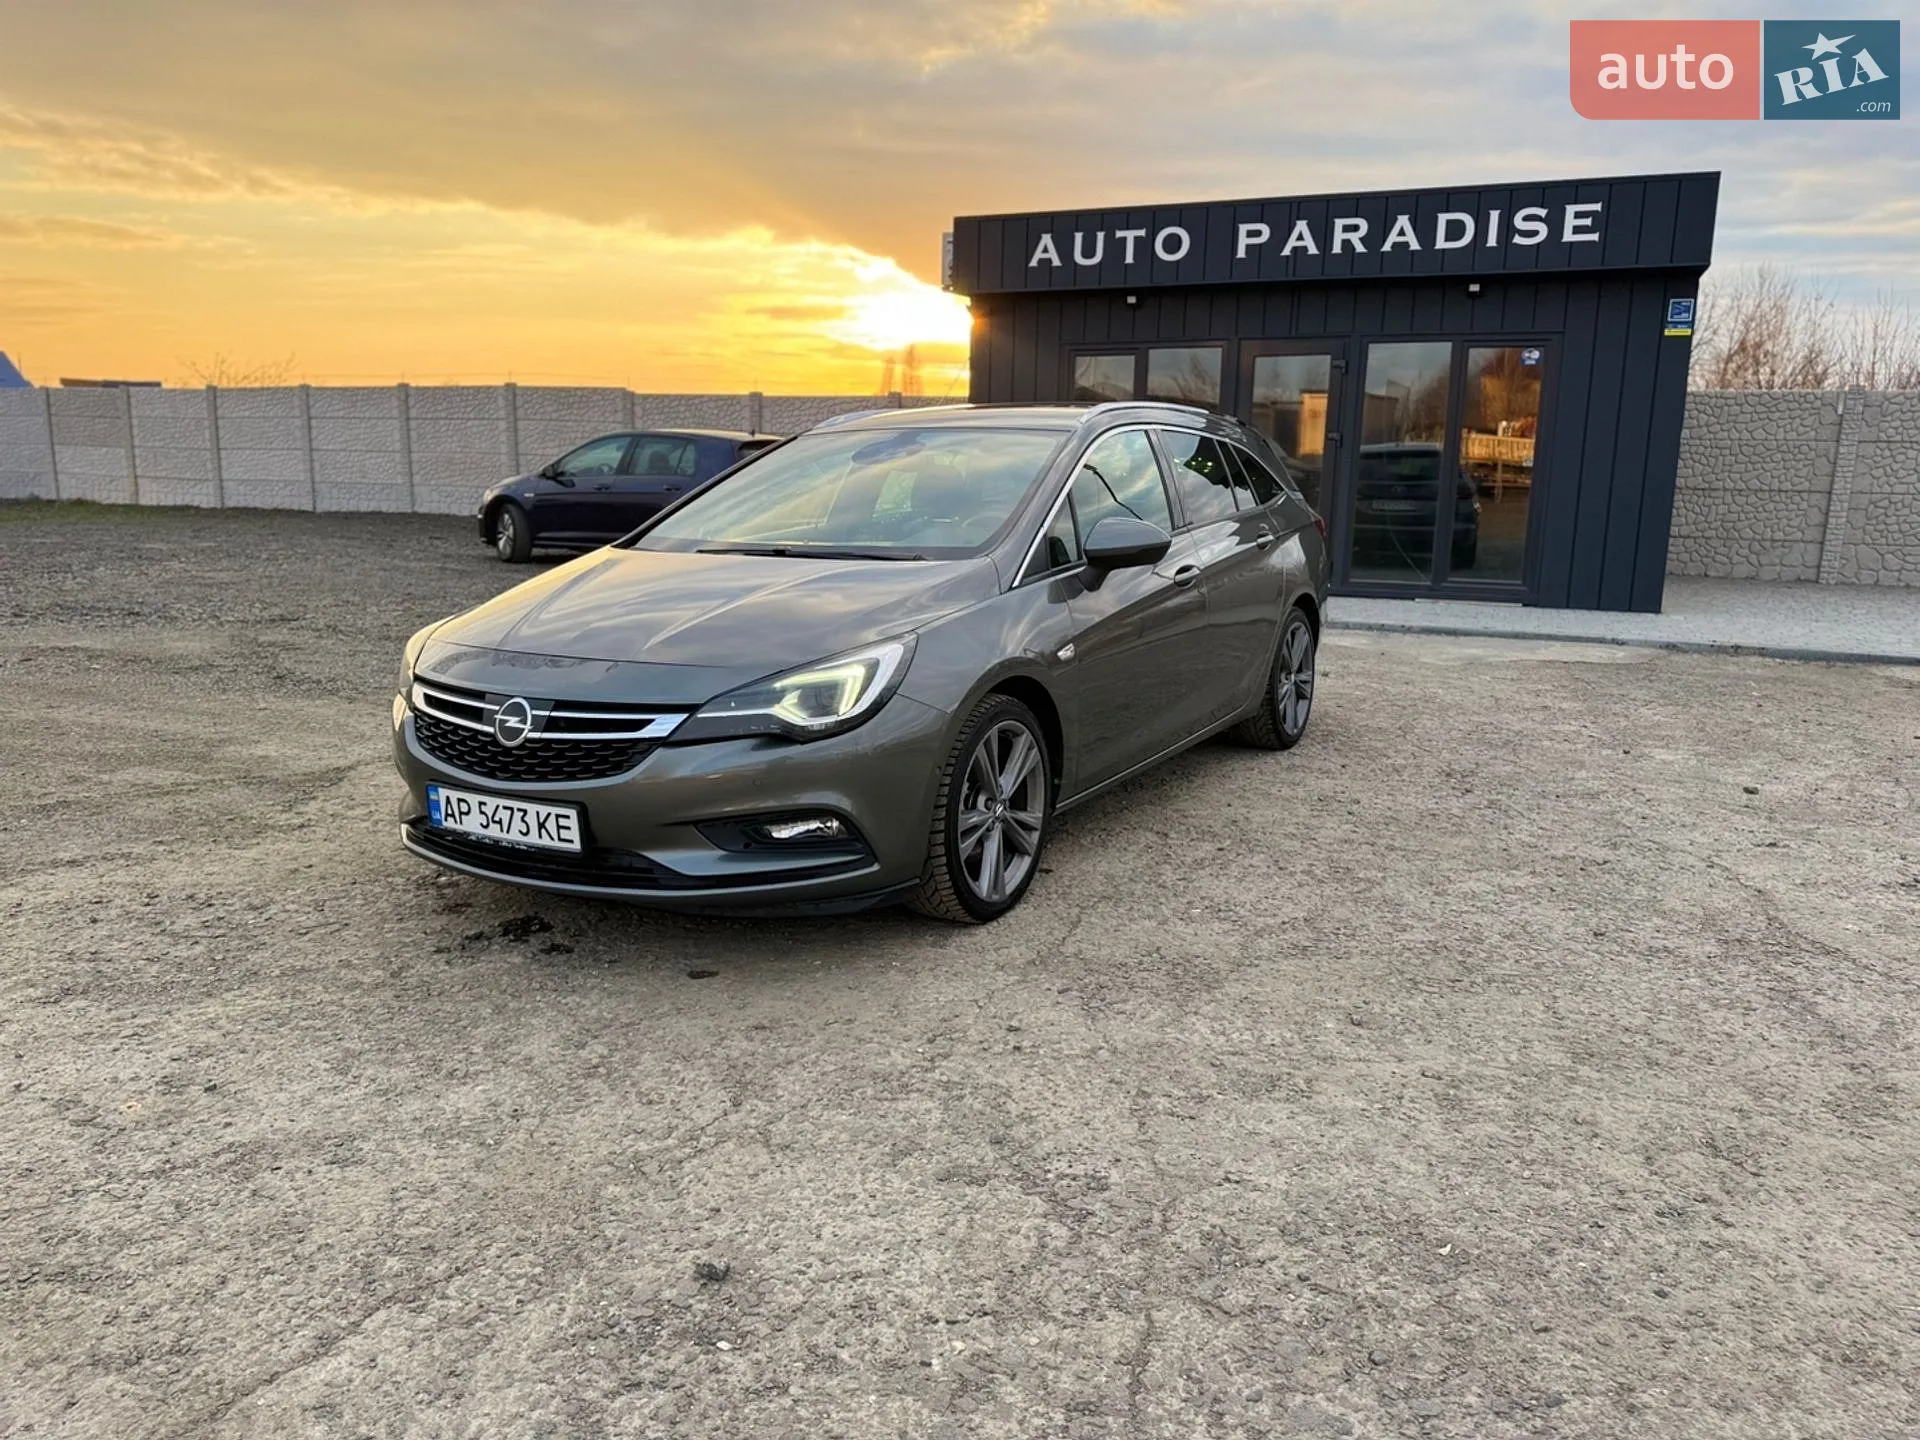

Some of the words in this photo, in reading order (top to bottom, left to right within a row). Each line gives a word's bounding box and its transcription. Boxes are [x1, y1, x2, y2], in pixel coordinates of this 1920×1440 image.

[1028, 225, 1191, 268] AUTO
[1235, 202, 1602, 259] PARADISE
[444, 795, 471, 826] AP
[478, 801, 530, 837] 5473
[536, 810, 574, 844] KE
